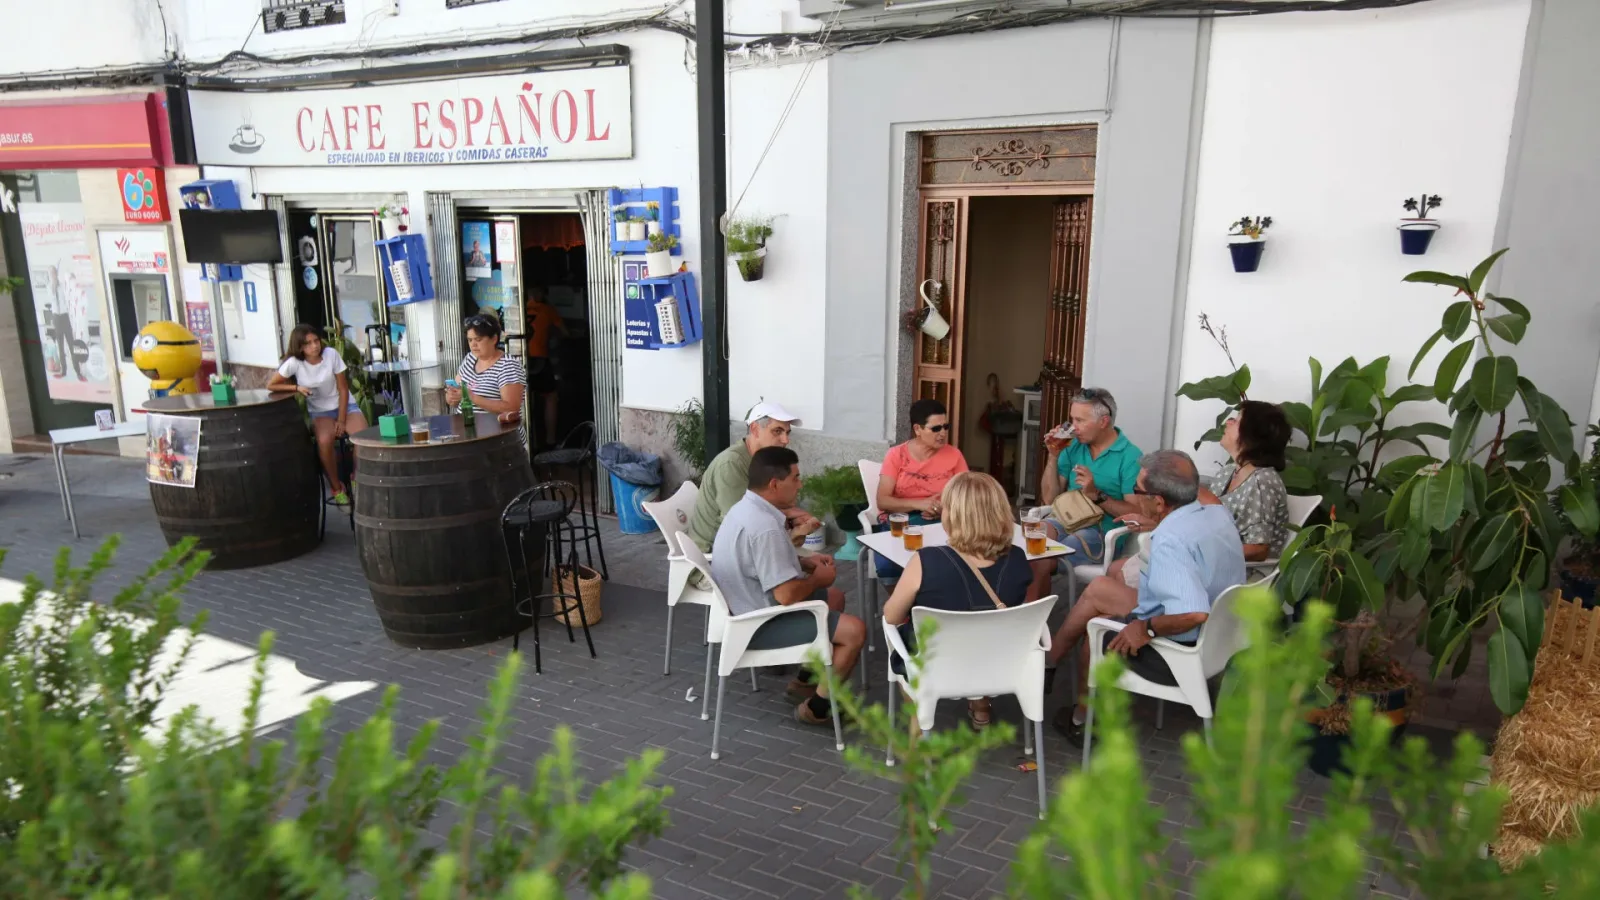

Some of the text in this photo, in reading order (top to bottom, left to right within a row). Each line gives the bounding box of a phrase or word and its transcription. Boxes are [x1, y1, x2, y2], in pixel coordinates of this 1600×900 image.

[296, 82, 611, 153] CAFE ESPAÑOL
[327, 152, 386, 164] ESPECIALIDAD
[389, 152, 401, 163] EN
[403, 151, 445, 163] IBERICOS
[456, 148, 502, 161] COMIDAS
[505, 146, 549, 159] CASERAS
[126, 211, 141, 220] EURO
